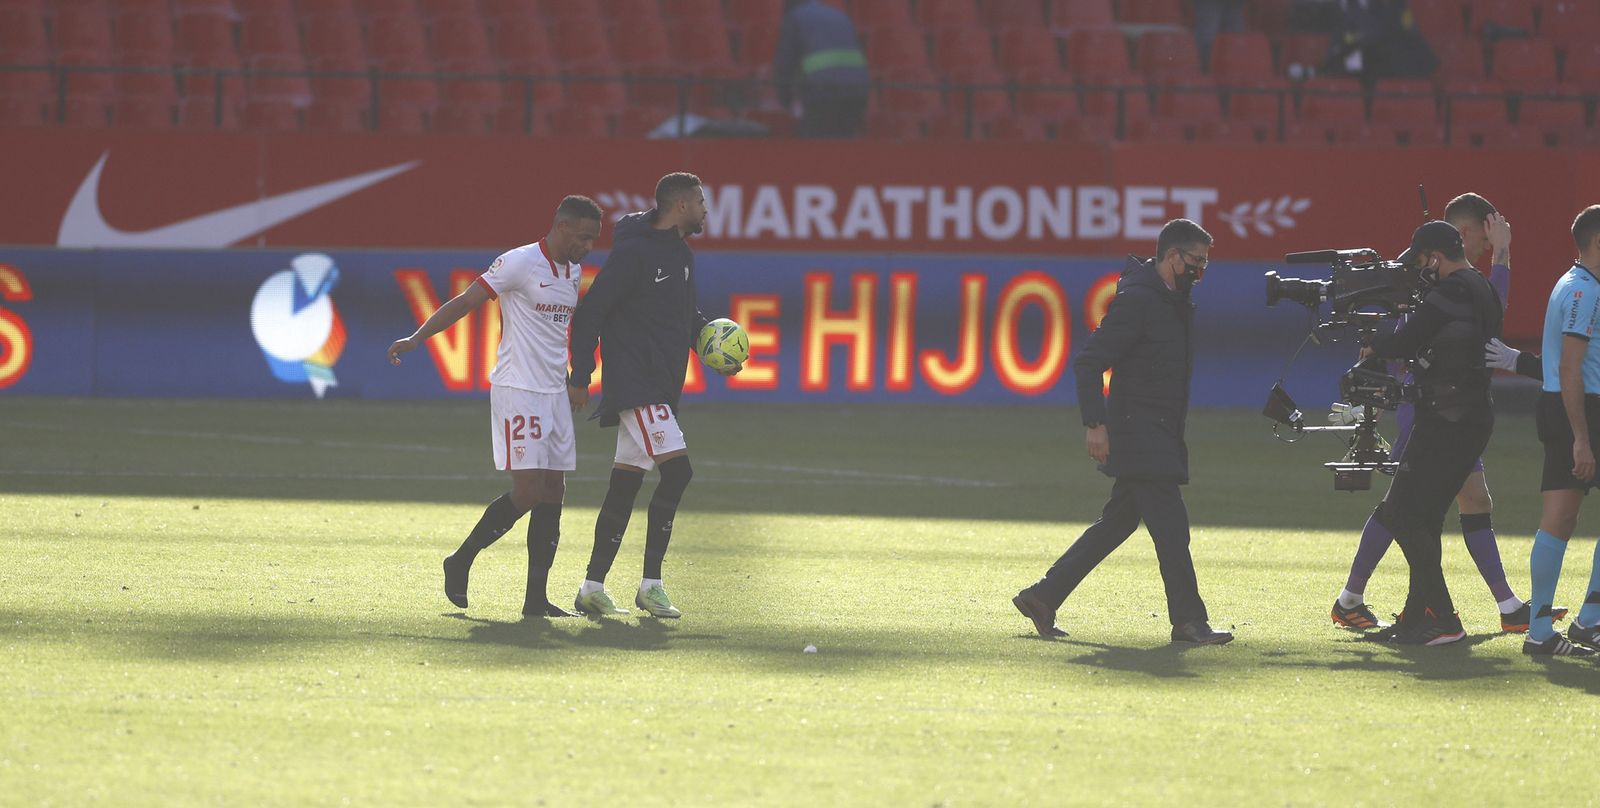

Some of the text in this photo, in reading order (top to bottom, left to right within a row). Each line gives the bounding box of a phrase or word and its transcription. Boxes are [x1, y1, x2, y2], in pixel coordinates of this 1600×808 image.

[692, 185, 1219, 239] MARATHONBET
[553, 313, 568, 323] BET
[642, 404, 670, 425] 15
[512, 415, 542, 441] 25
